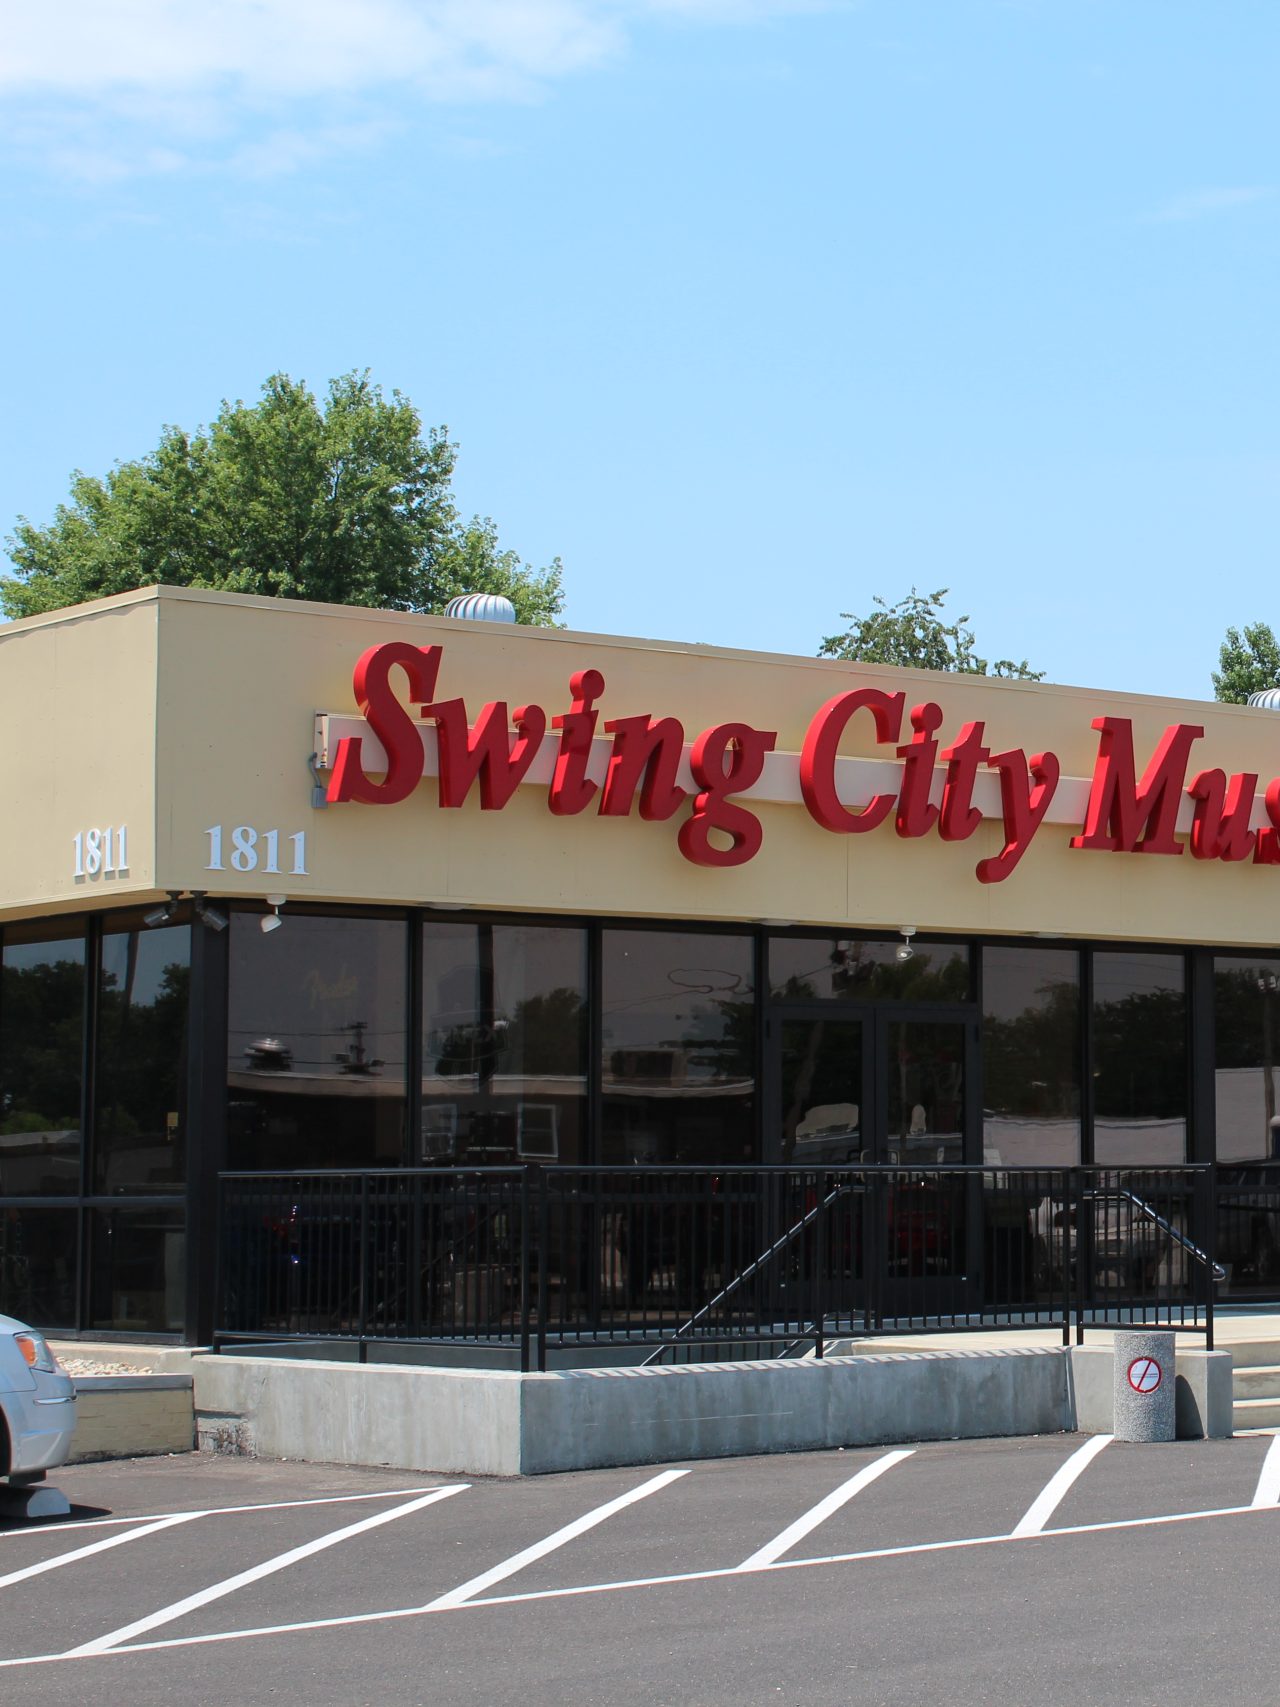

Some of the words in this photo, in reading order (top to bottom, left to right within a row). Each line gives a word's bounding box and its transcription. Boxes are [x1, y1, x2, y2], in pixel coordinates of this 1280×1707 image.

[326, 642, 777, 867] Swing
[799, 688, 1060, 884] City
[72, 824, 129, 877] 1811
[203, 825, 310, 876] 1811
